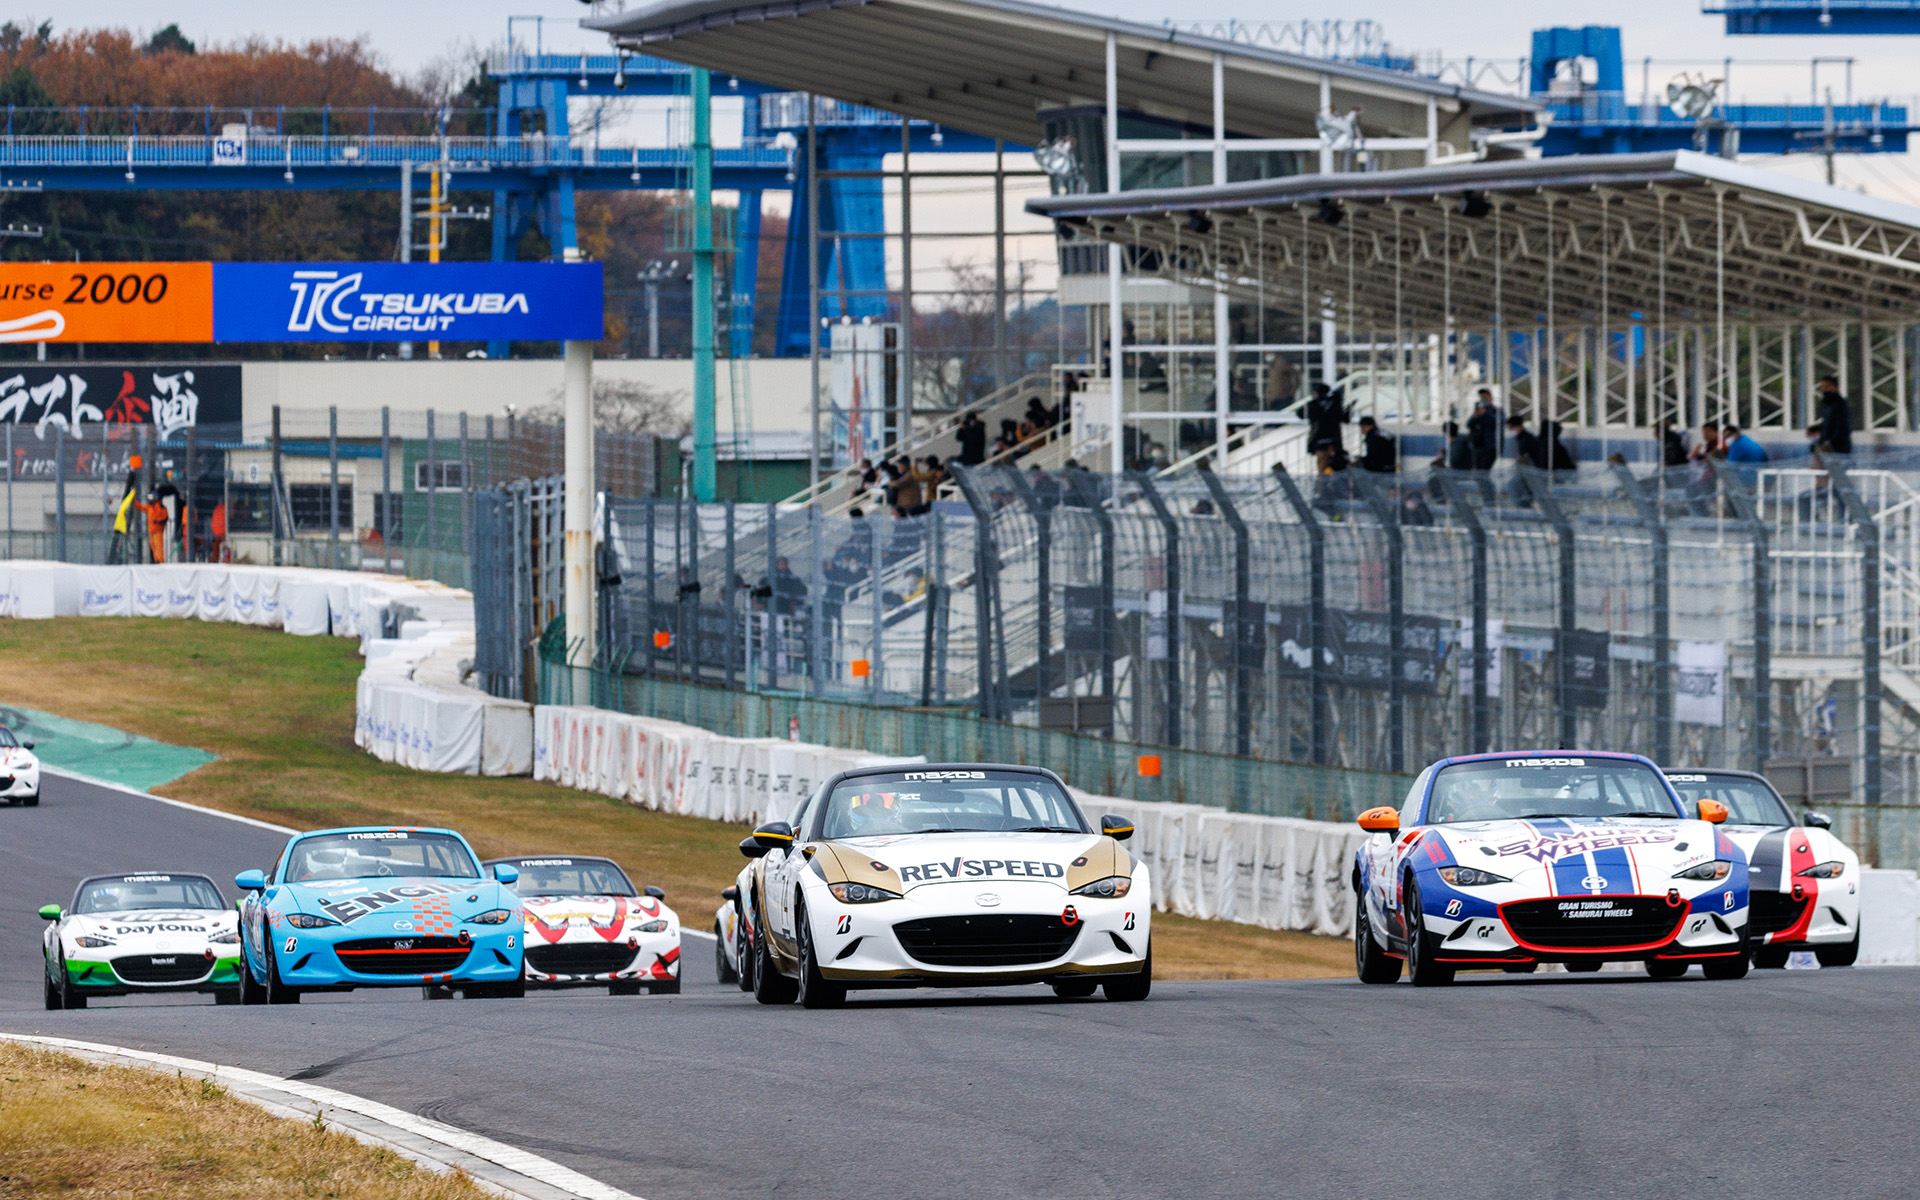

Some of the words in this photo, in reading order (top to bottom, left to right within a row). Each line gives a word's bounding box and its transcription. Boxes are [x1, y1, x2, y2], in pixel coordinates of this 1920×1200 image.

[64, 273, 168, 304] 2000
[360, 293, 529, 314] TSUKUBA
[1498, 827, 1680, 857] SAMURAI
[1526, 834, 1676, 863] WHEELS
[321, 882, 482, 927] ENGI
[1558, 902, 1579, 910] GRAN
[1581, 901, 1613, 909] TURISMO
[1604, 909, 1633, 917] WHEELS
[116, 923, 206, 935] Daytona
